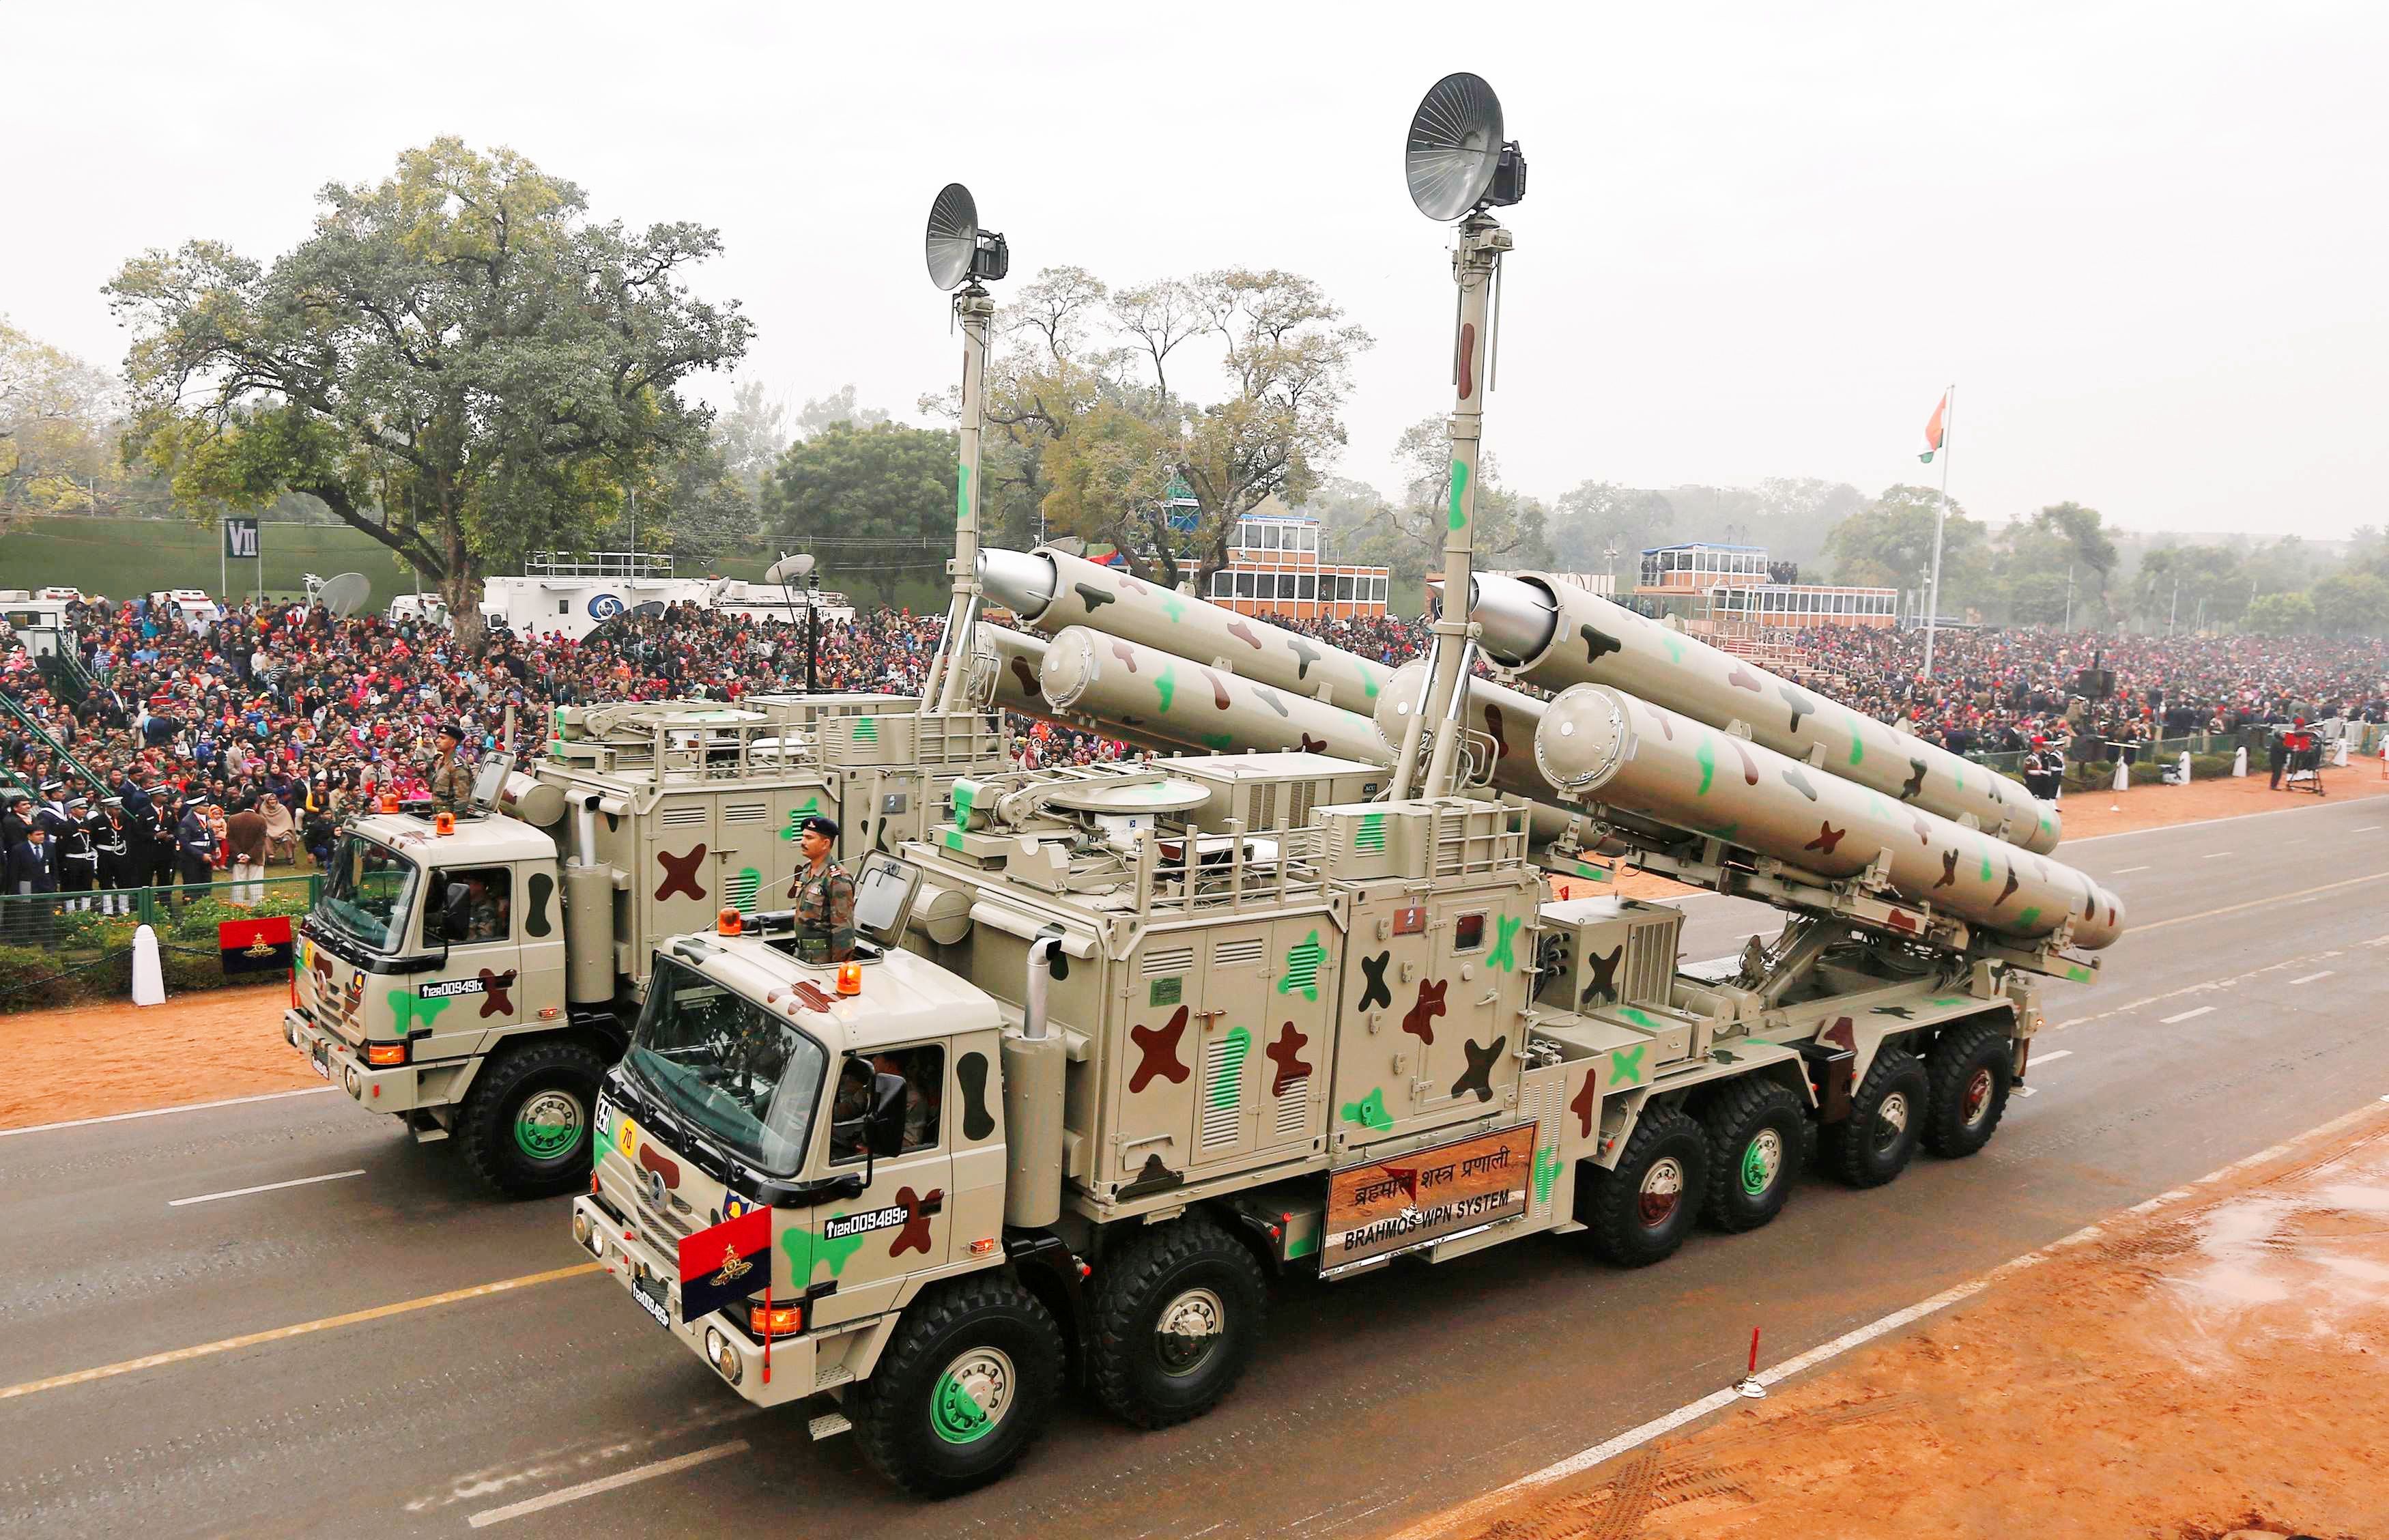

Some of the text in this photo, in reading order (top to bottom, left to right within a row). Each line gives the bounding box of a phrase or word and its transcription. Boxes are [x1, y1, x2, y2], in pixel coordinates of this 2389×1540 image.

[228, 521, 257, 556] VII
[623, 1127, 632, 1150] 70
[1420, 1164, 1456, 1188] शस्त्र
[1461, 1145, 1511, 1178] प्रणाली
[1343, 1188, 1510, 1251] BRAHMOS WPN SYSTEM
